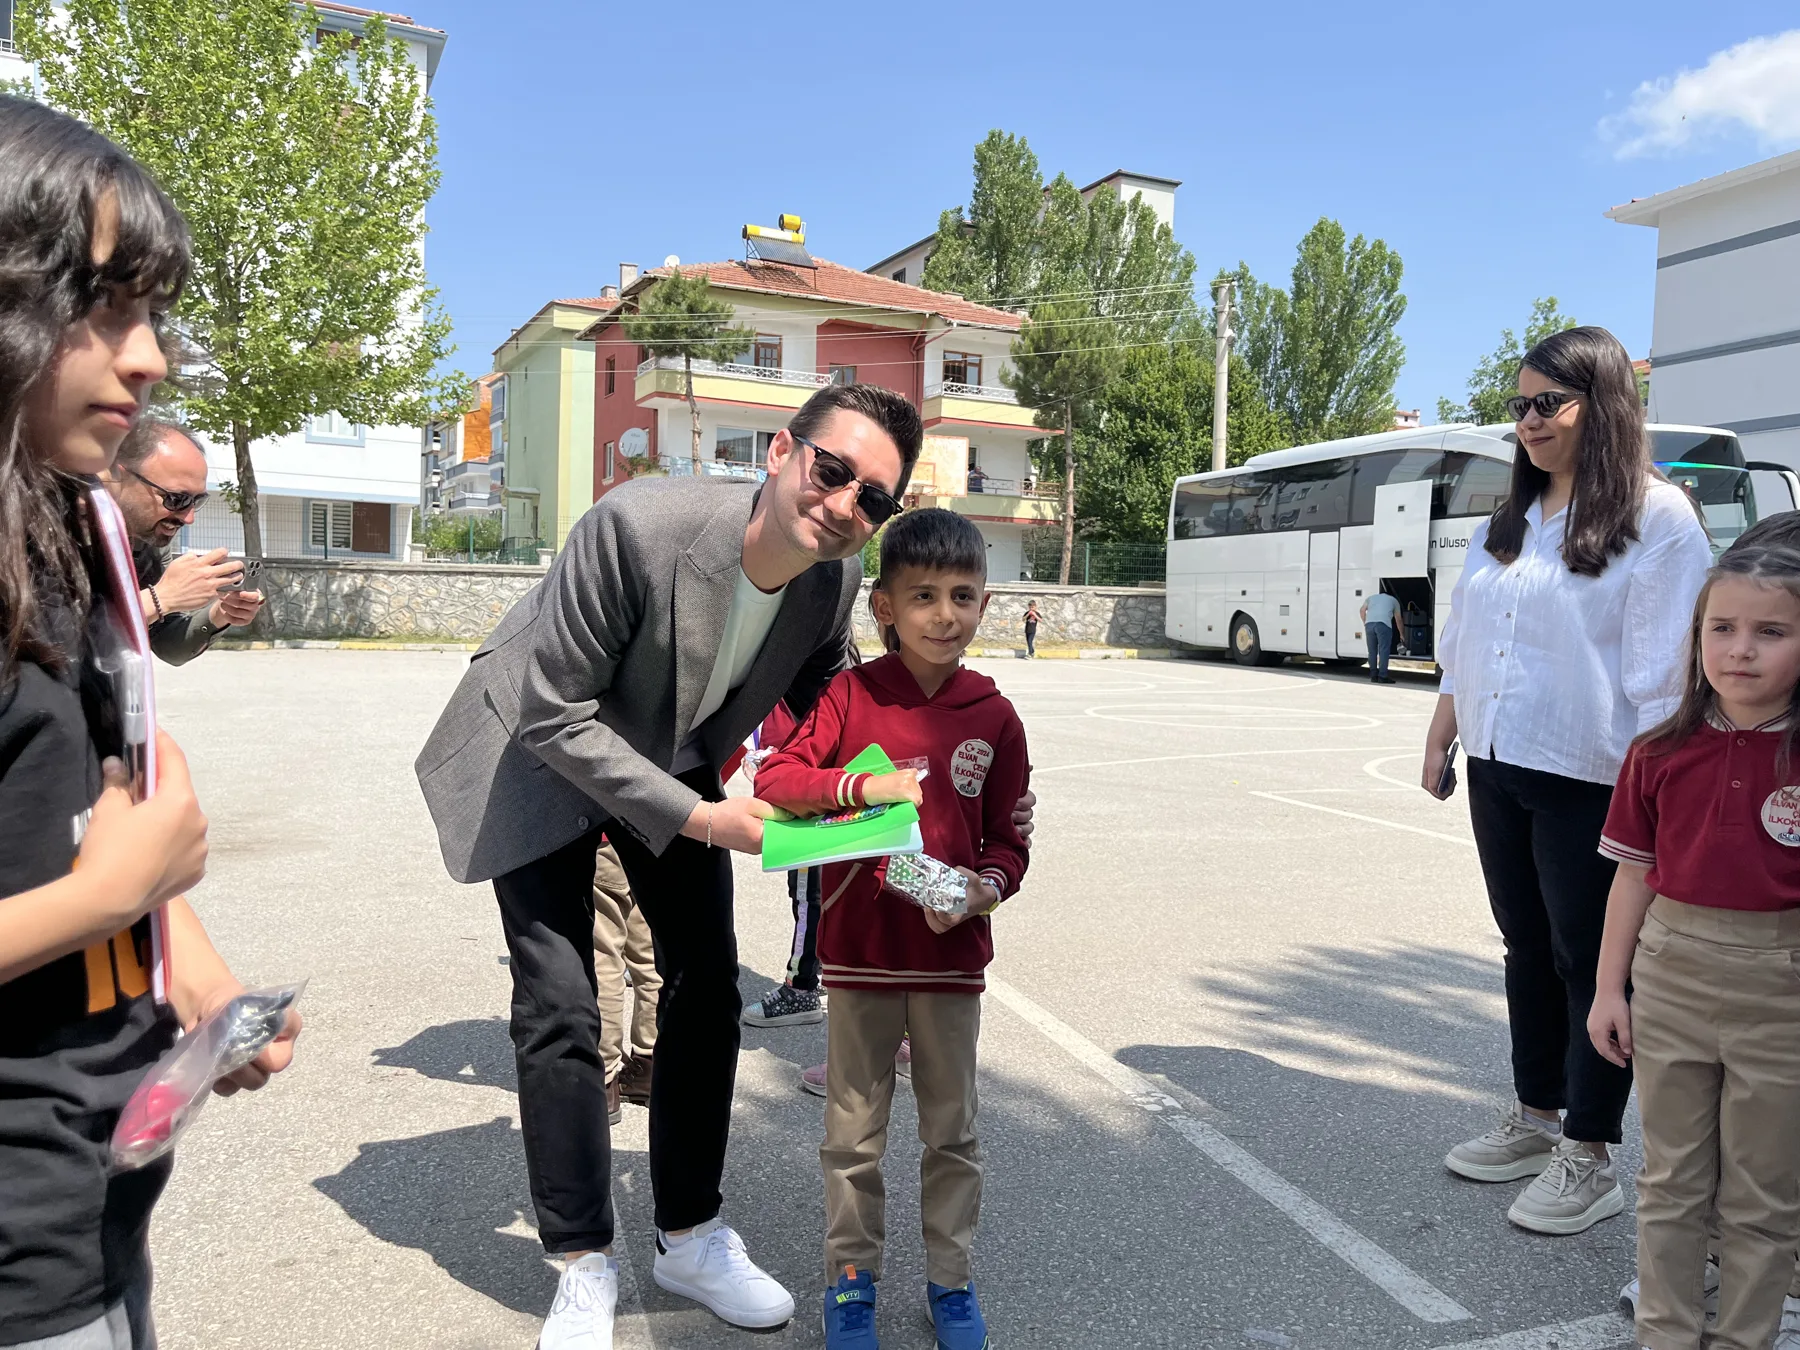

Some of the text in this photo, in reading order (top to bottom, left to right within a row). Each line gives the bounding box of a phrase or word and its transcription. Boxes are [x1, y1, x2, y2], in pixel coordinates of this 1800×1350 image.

[1440, 537, 1471, 550] Ulusoy
[958, 751, 979, 763] ELVAN
[1770, 799, 1798, 810] ELVAN
